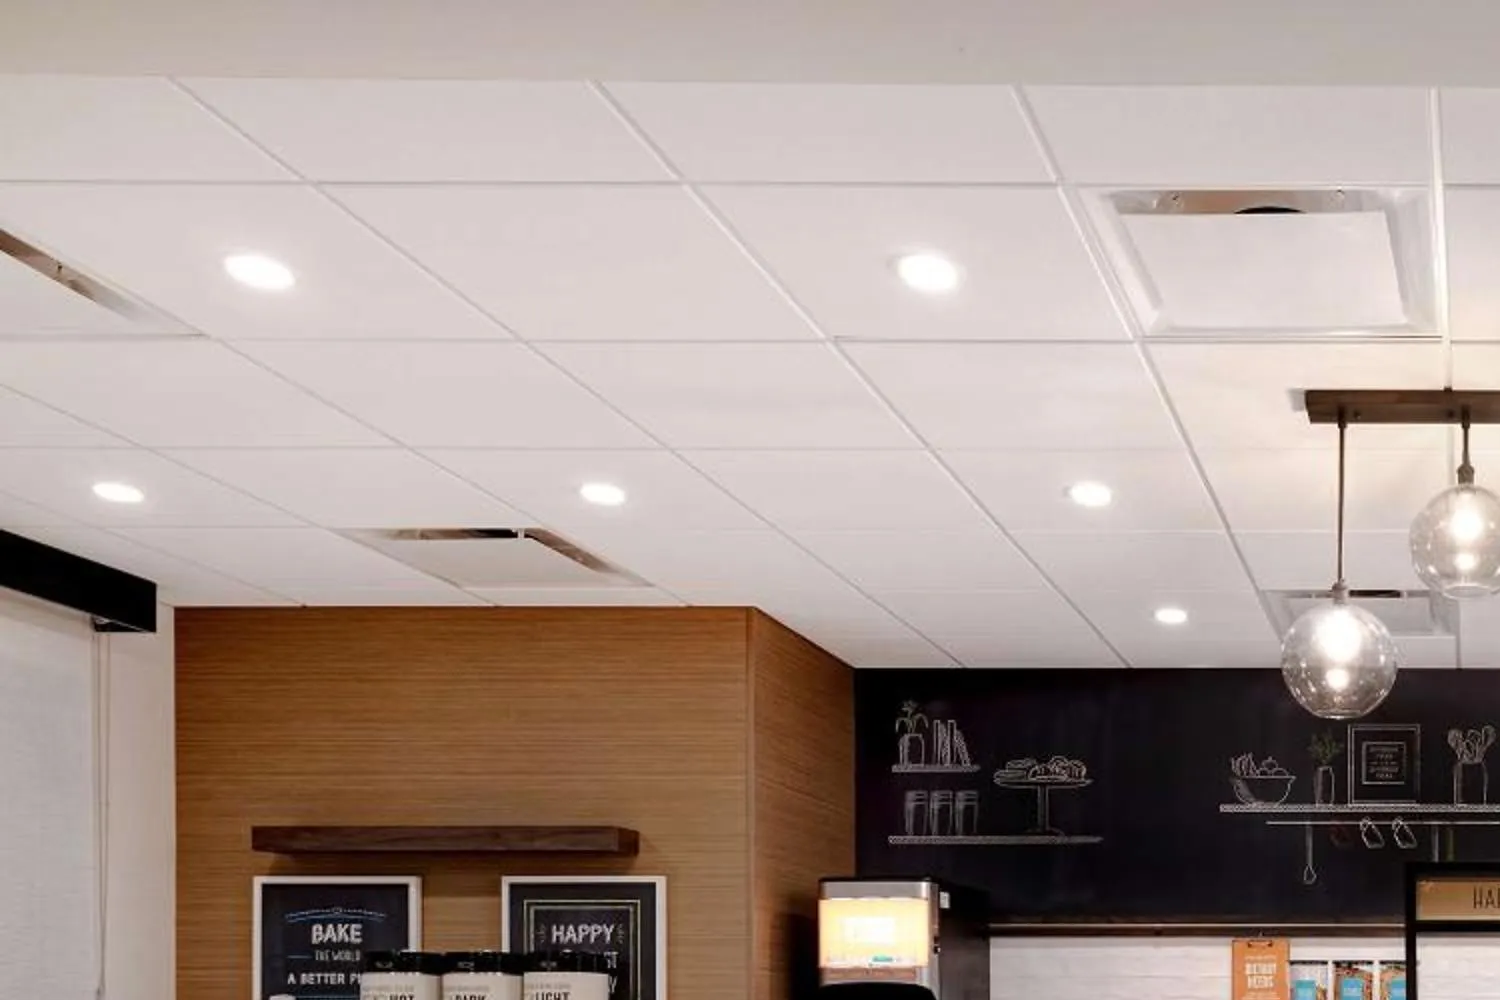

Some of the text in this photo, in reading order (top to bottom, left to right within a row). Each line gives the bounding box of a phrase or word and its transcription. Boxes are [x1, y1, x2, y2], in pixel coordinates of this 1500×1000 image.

[311, 923, 363, 945] BAKE
[551, 923, 615, 944] HAPPY
[287, 972, 297, 985] A
[300, 972, 345, 985] BETTER
